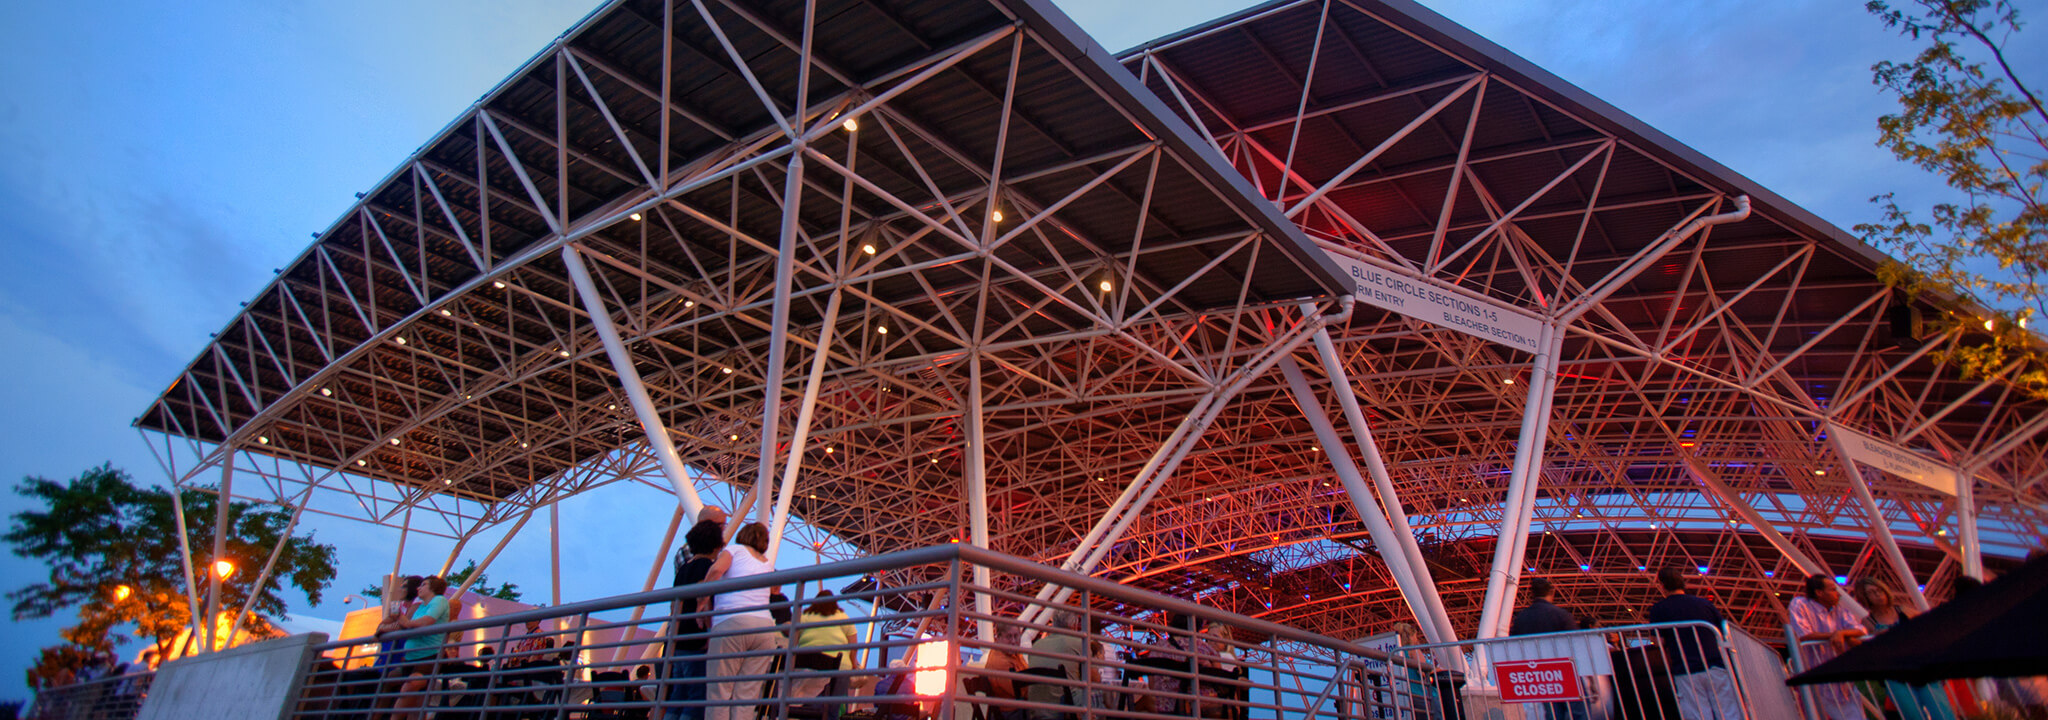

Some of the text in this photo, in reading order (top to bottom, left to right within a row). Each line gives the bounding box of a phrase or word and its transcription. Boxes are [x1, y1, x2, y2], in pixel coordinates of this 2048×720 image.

[1351, 265, 1498, 322] BLUE CIRCLE SECTIONS 1-5
[1375, 289, 1405, 307] ENTRY
[1443, 311, 1537, 348] BLEACHER SECTION 13
[1508, 669, 1564, 684] SECTION
[1513, 682, 1564, 697] CLOSED
